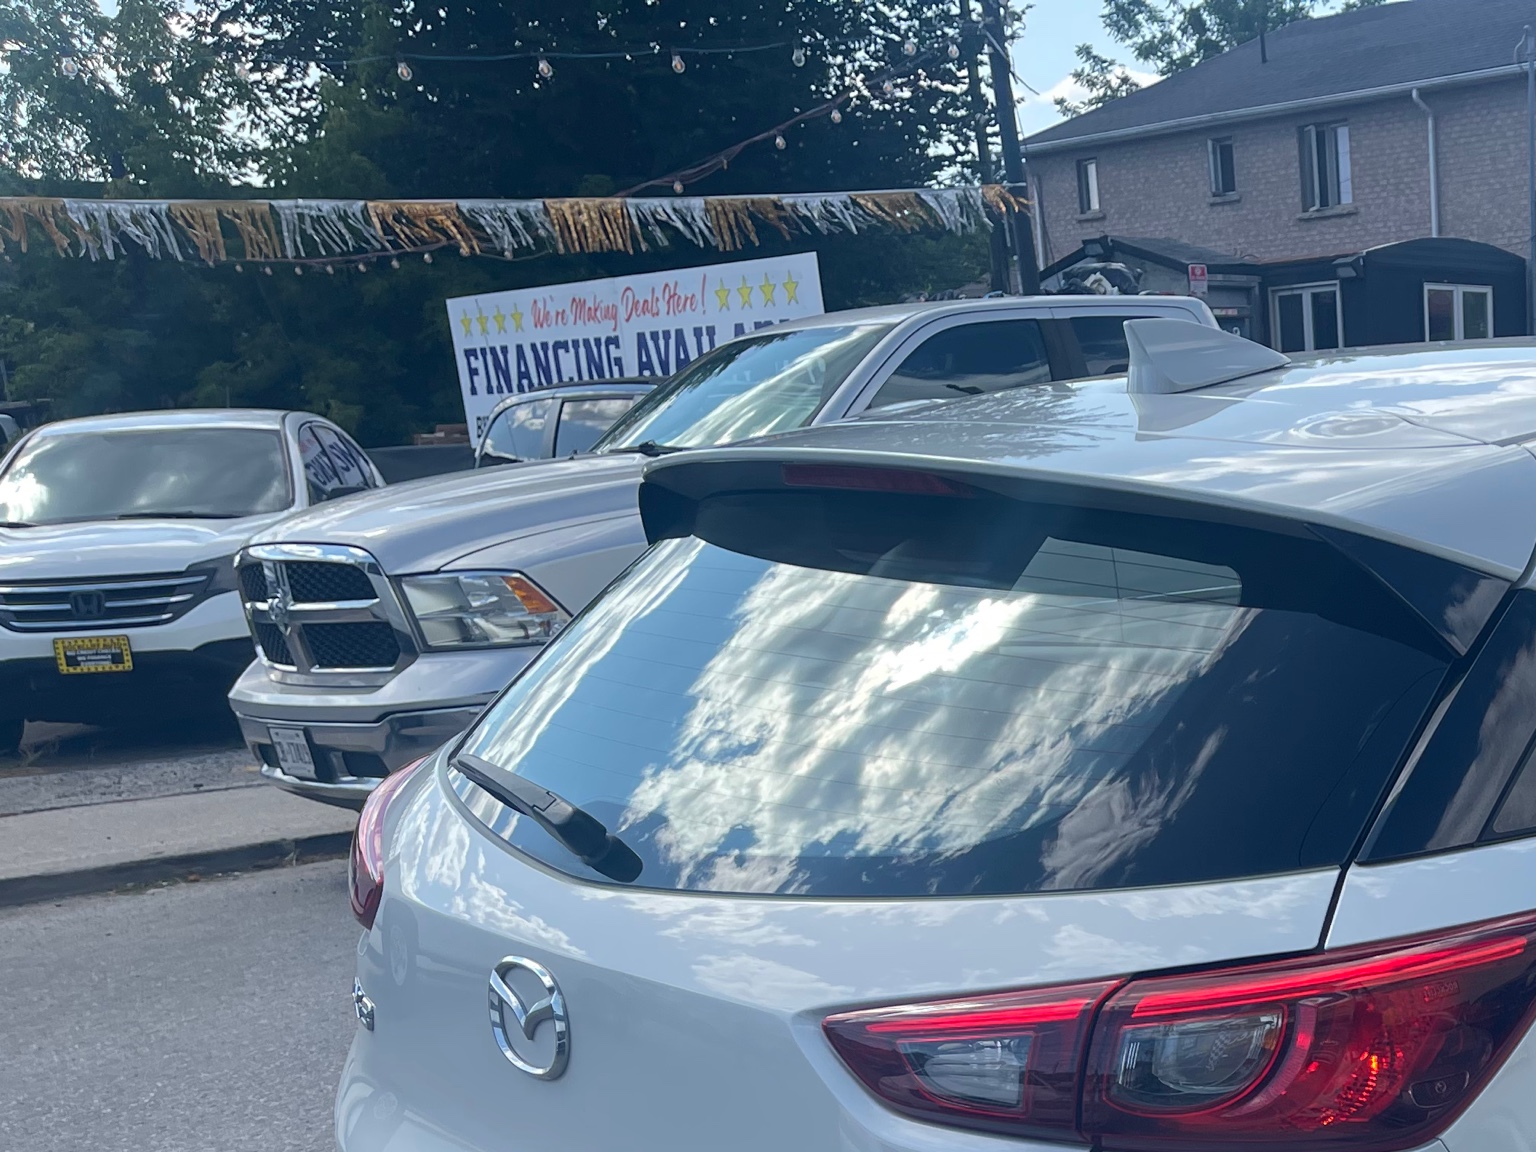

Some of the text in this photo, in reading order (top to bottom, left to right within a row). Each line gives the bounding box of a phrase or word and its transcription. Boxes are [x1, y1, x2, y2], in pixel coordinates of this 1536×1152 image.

[531, 294, 567, 328] We're
[571, 294, 618, 332] Making
[621, 286, 659, 323] Deals
[464, 335, 625, 395] FINANCING
